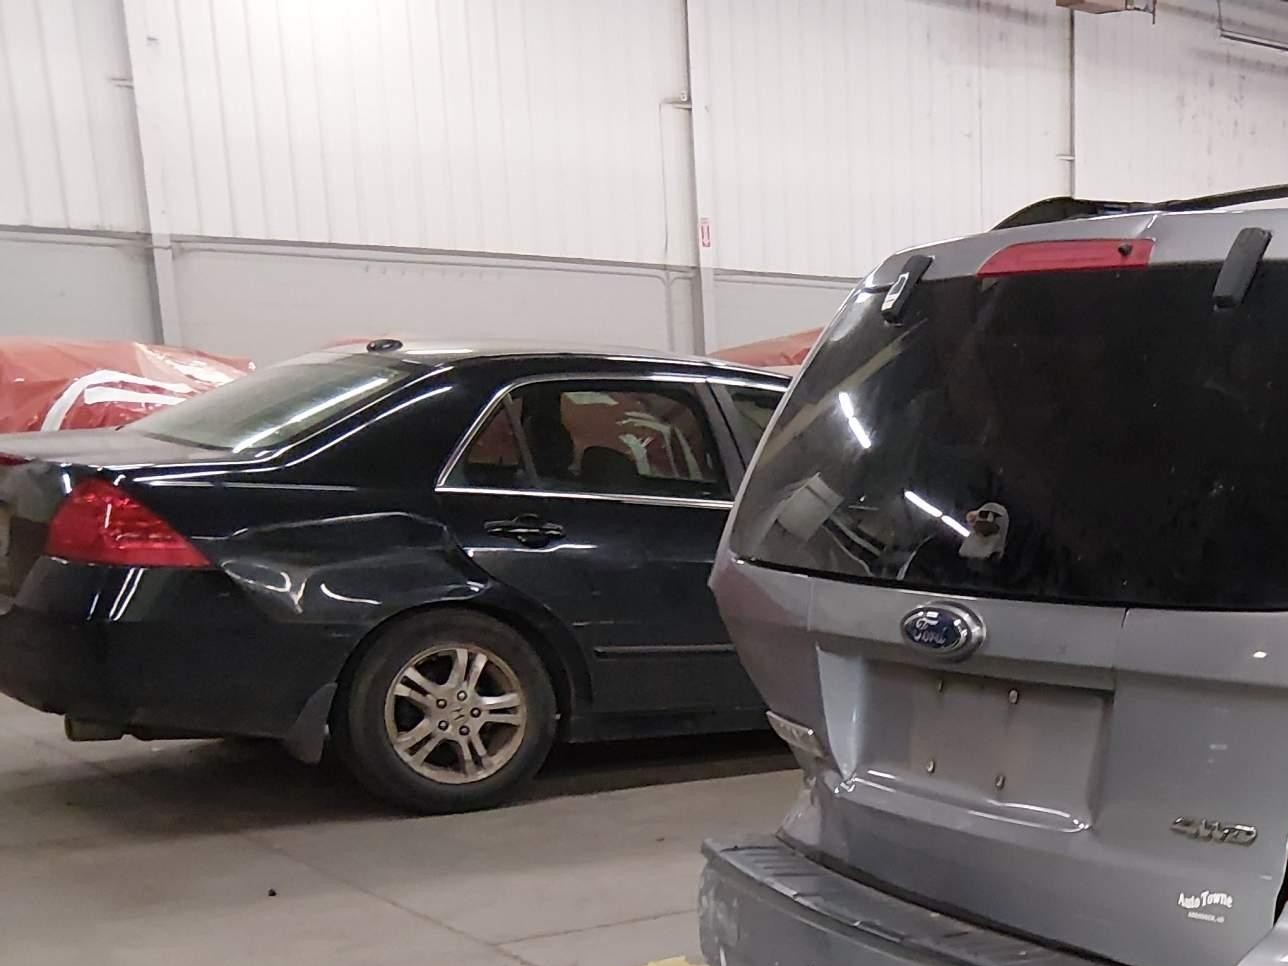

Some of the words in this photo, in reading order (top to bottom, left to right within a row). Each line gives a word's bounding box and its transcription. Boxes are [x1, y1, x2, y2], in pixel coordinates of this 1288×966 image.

[914, 617, 949, 645] Ford
[1178, 892, 1201, 909] Auto
[1200, 890, 1233, 909] Towne
